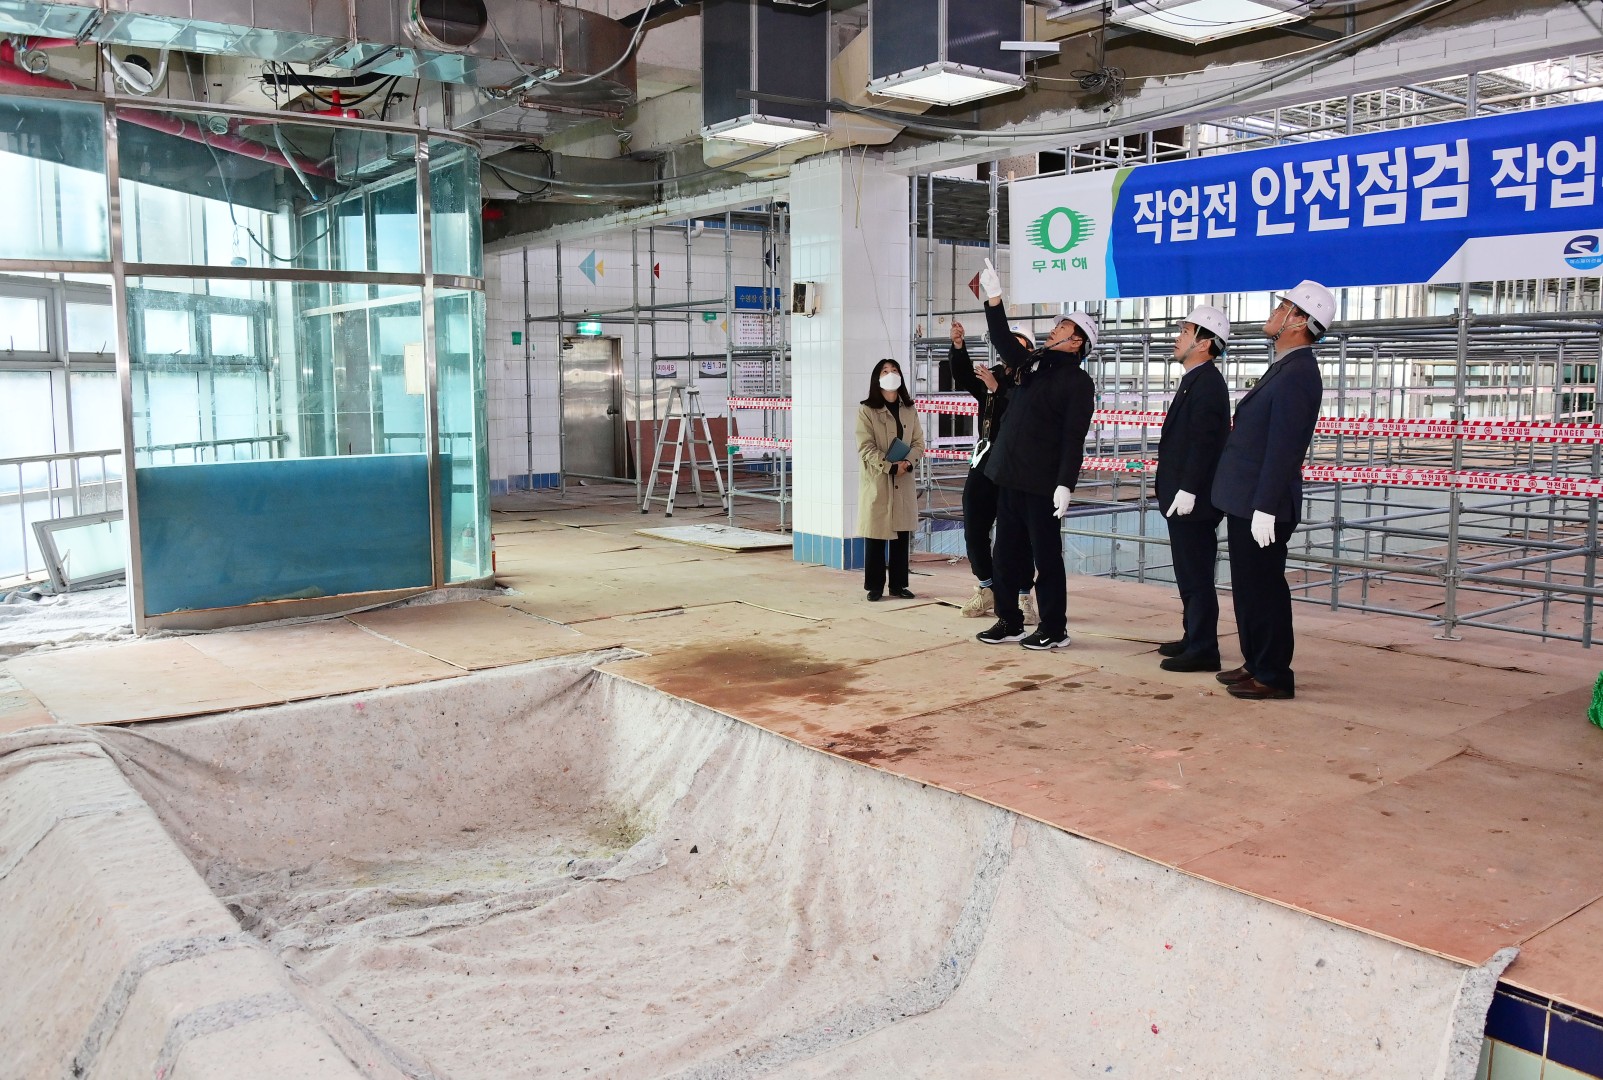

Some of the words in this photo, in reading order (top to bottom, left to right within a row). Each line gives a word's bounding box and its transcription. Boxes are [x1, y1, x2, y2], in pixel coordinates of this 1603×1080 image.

[1132, 180, 1236, 244] 작업전
[1251, 138, 1470, 237] 안전점검
[1490, 136, 1603, 211] 작업
[1031, 256, 1089, 273] 무재해
[1317, 421, 1342, 429] DANGER
[1381, 423, 1408, 431] 안전제일
[1427, 425, 1455, 433] DANGER
[1463, 426, 1476, 434] 위험
[1500, 427, 1530, 435] 안전제일
[1553, 429, 1585, 437] DANGER
[1421, 474, 1448, 482] 안전제일
[1469, 476, 1498, 484] DANGER
[1506, 478, 1520, 486] 위험
[1546, 481, 1577, 490] 안전제일
